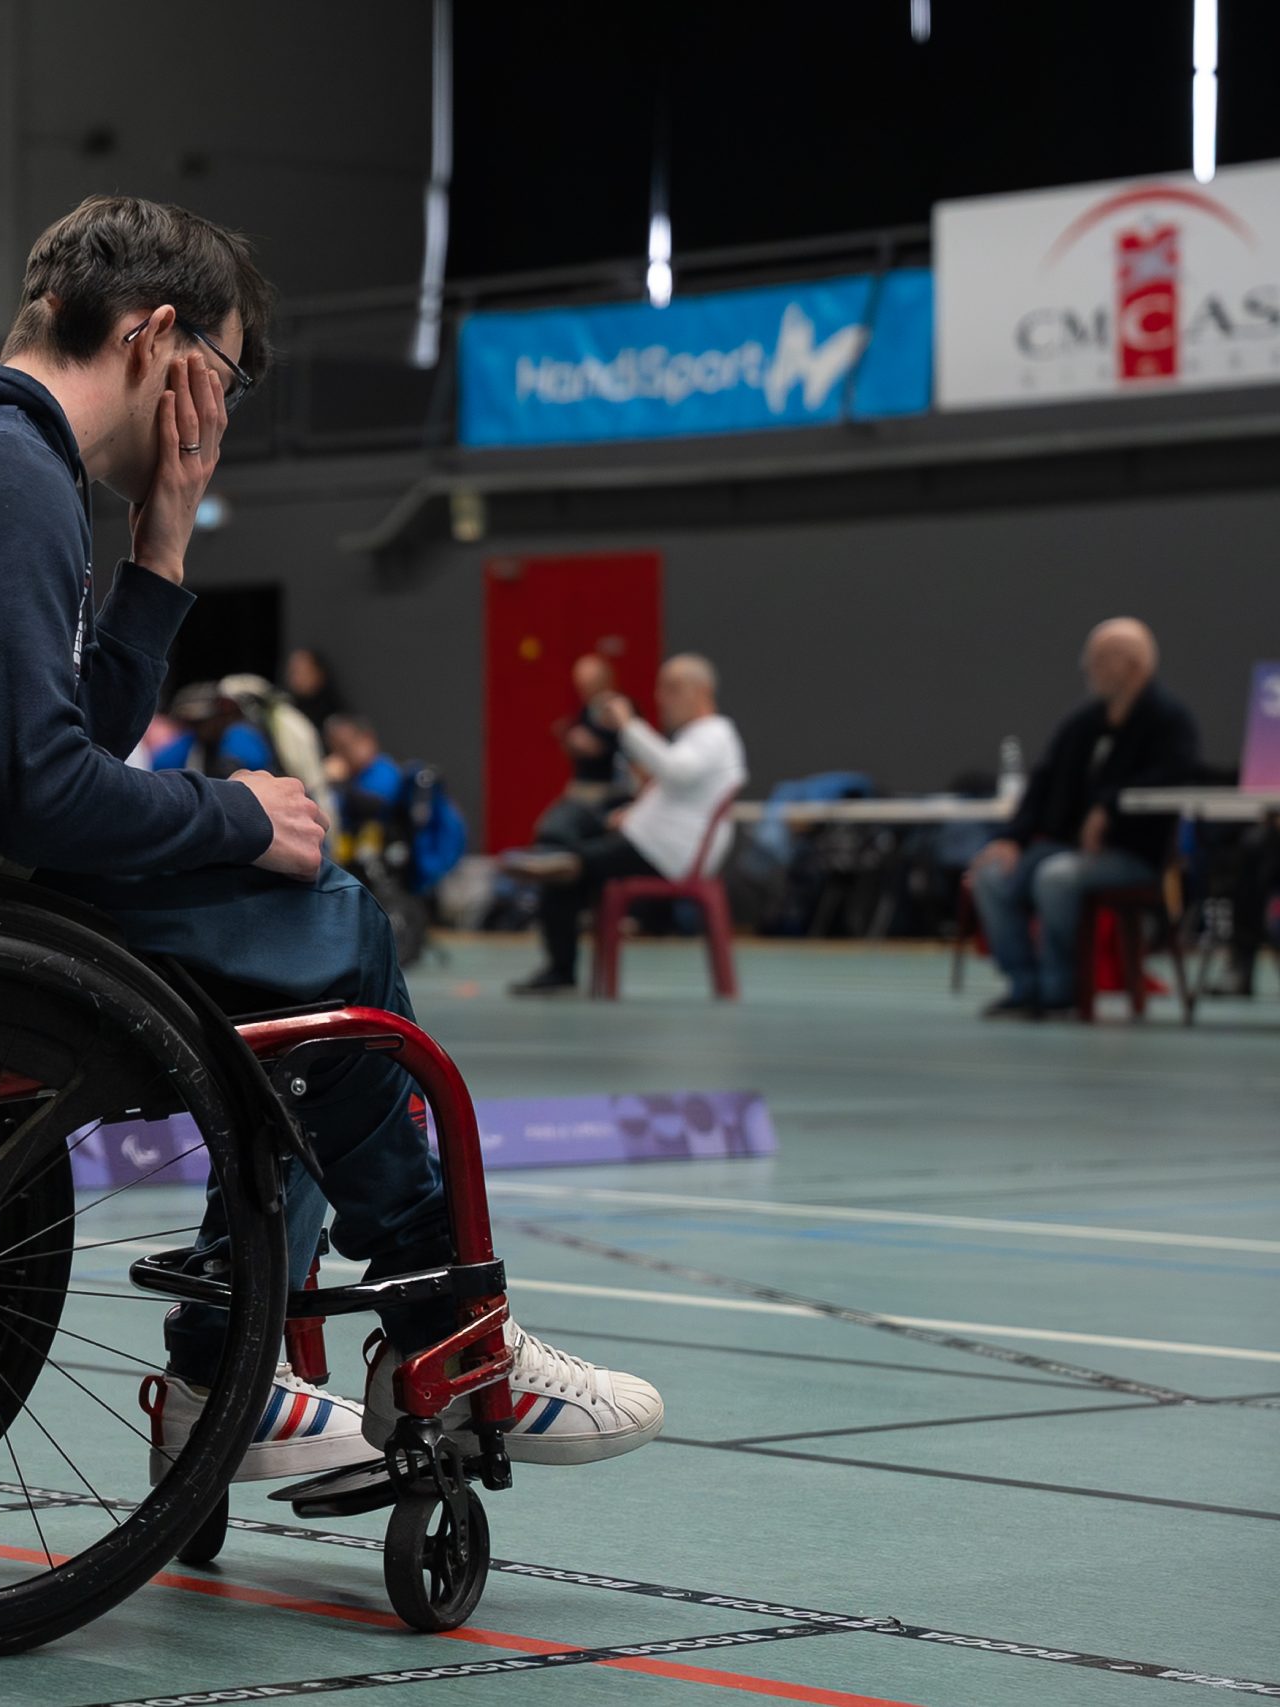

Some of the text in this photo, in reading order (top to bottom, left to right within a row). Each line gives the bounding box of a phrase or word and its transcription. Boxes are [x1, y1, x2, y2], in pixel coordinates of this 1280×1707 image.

[368, 1660, 544, 1683] BOCCIA
[609, 1633, 776, 1655] BOCCIA
[501, 1563, 1280, 1695] OCCIA BOCCIA BOCCIA BOCCIA
